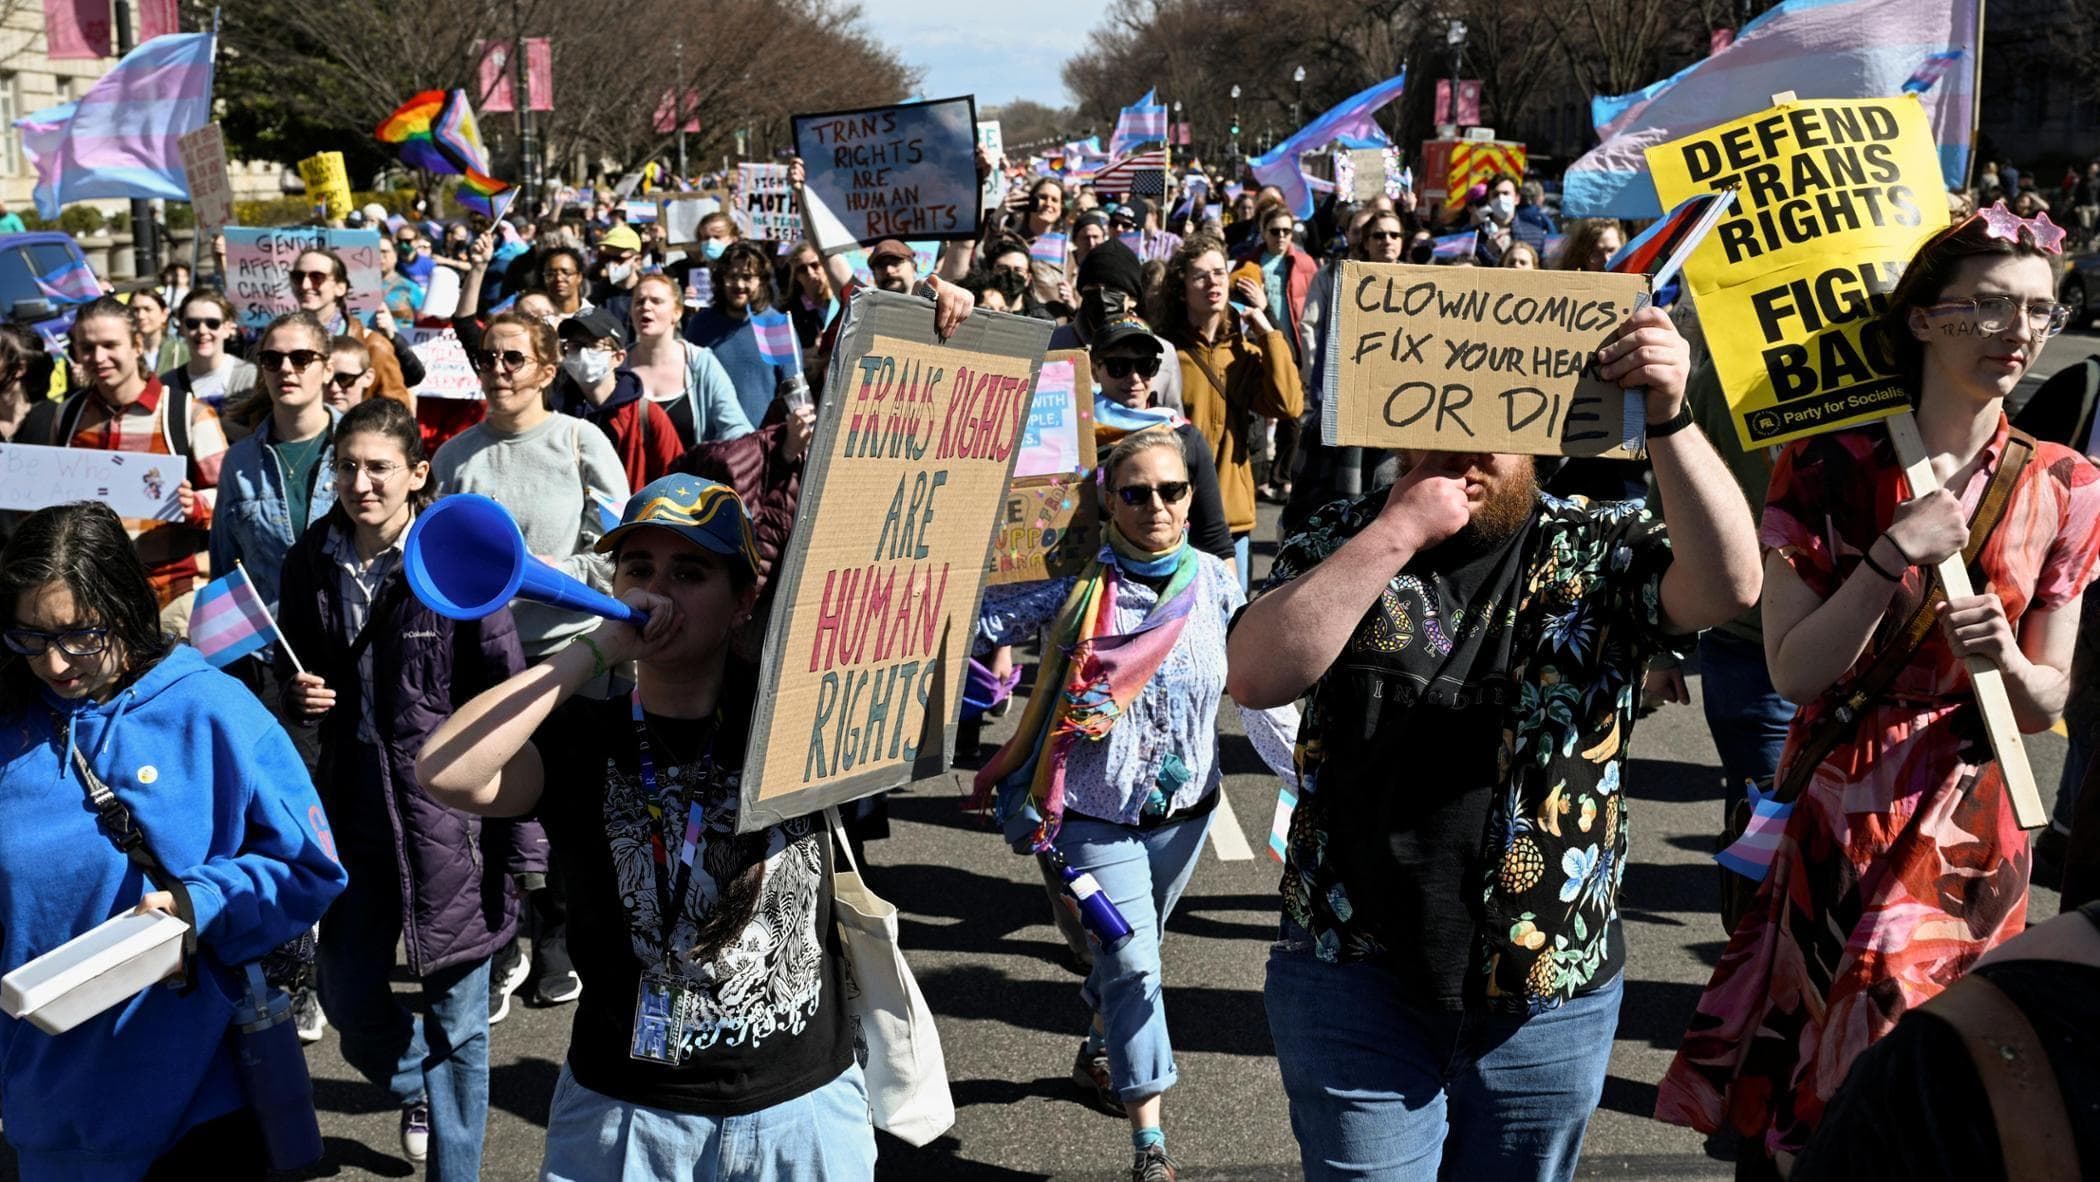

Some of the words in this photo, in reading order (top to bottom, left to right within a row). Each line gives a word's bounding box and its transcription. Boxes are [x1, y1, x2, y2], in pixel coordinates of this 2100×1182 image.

[811, 112, 896, 144] TRANS
[834, 139, 923, 168] RIGHTS
[1681, 105, 1900, 183] DEFEND
[845, 184, 919, 212] HUMAN
[853, 167, 892, 189] ARE
[1710, 143, 1901, 217] TRANS
[867, 205, 958, 237] RIGHTS
[1717, 185, 1922, 265] RIGHTS
[239, 258, 289, 281] AFFIR
[1355, 275, 1490, 322] CLOWN
[1751, 262, 1910, 344] FIGH
[1350, 326, 1434, 364] FIX
[1445, 339, 1527, 376] YOUR
[1533, 346, 1607, 382] HEAR
[1761, 319, 1901, 403] BAC
[844, 356, 944, 460] TRANS
[935, 366, 1029, 462] RIGHTS
[1383, 381, 1475, 437] OR
[1498, 387, 1609, 442] DIE
[1783, 406, 1821, 425] Party
[1824, 400, 1846, 415] for
[1847, 386, 1905, 408] Socialis
[7, 447, 40, 477] Be
[55, 449, 113, 481] Who
[874, 470, 948, 561] ARE
[809, 563, 950, 673] HUMAN
[803, 658, 937, 783] RIGHTS
